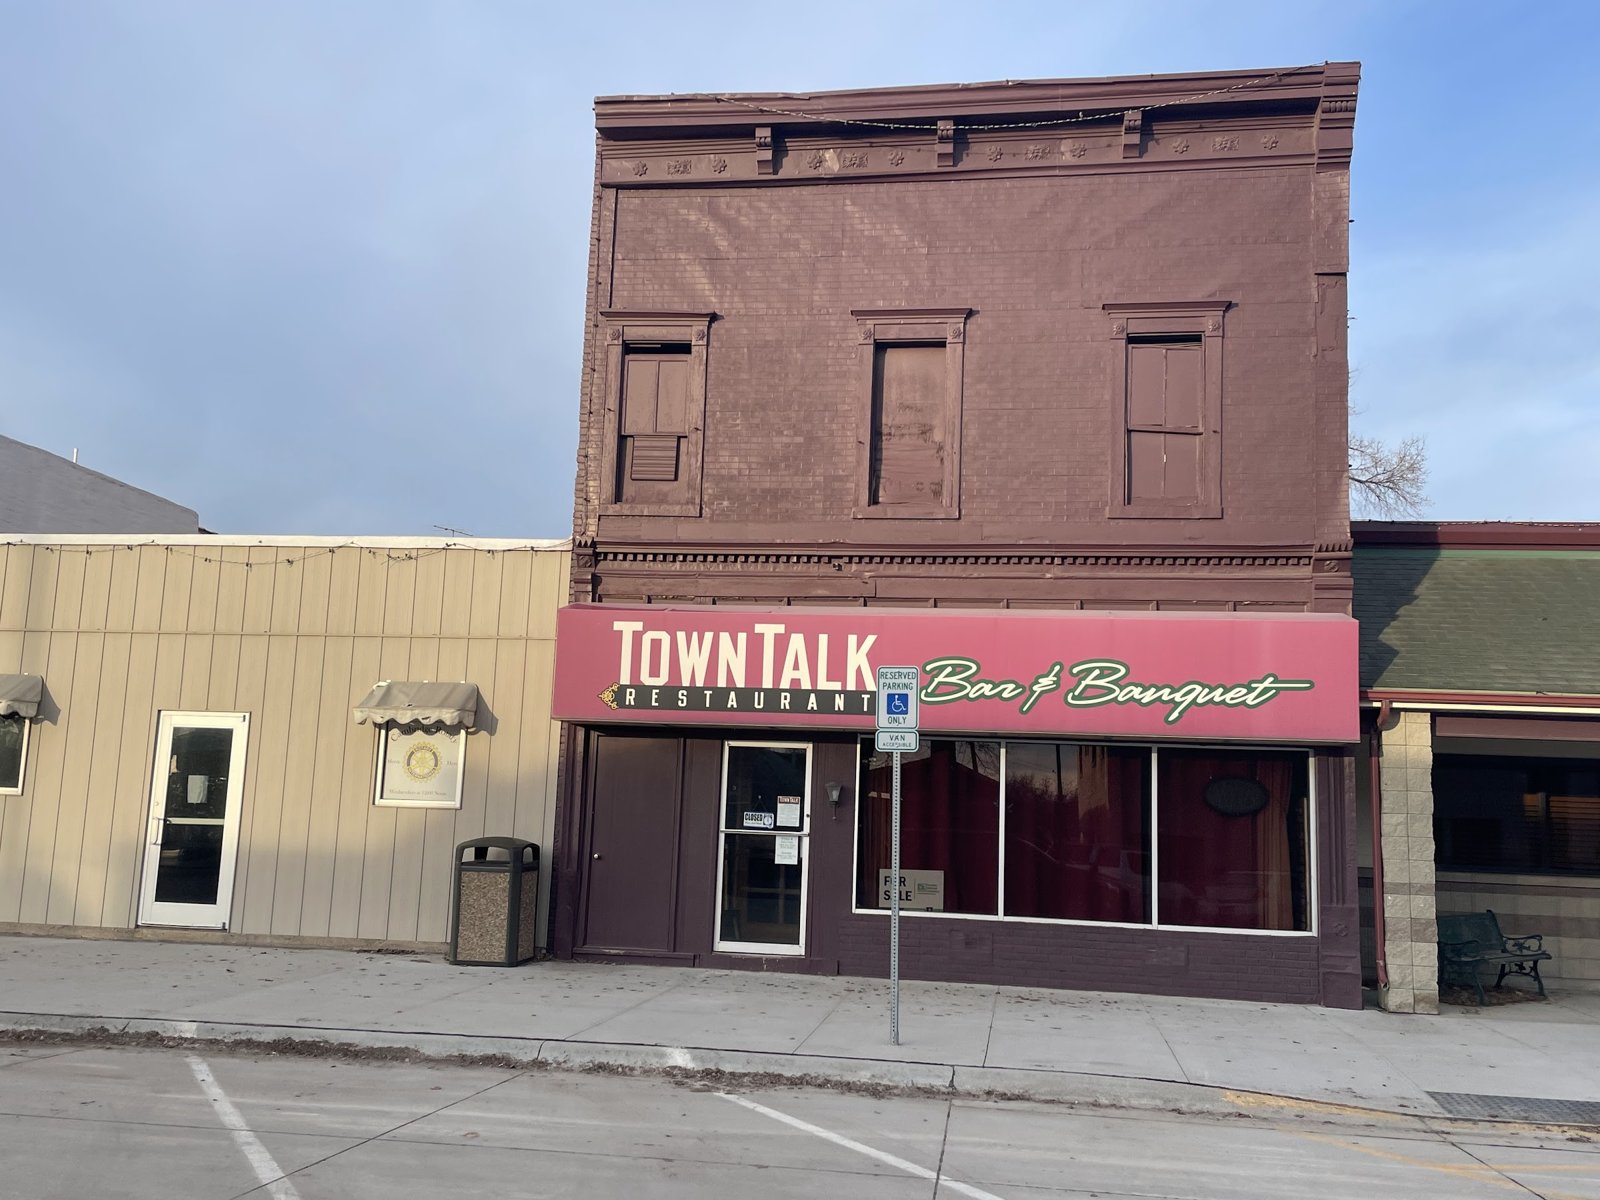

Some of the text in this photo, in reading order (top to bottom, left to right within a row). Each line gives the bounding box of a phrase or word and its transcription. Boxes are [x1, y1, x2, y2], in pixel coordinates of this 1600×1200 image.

[880, 671, 916, 680] RESERVED
[882, 682, 913, 691] PARKING
[921, 657, 1314, 725] Bar & Banquet
[625, 688, 870, 712] RESTAURANT
[887, 716, 907, 725] ONLY
[889, 734, 906, 742] VAN
[745, 813, 763, 822] CLOSED
[884, 875, 906, 887] FR
[883, 890, 912, 901] SLE
